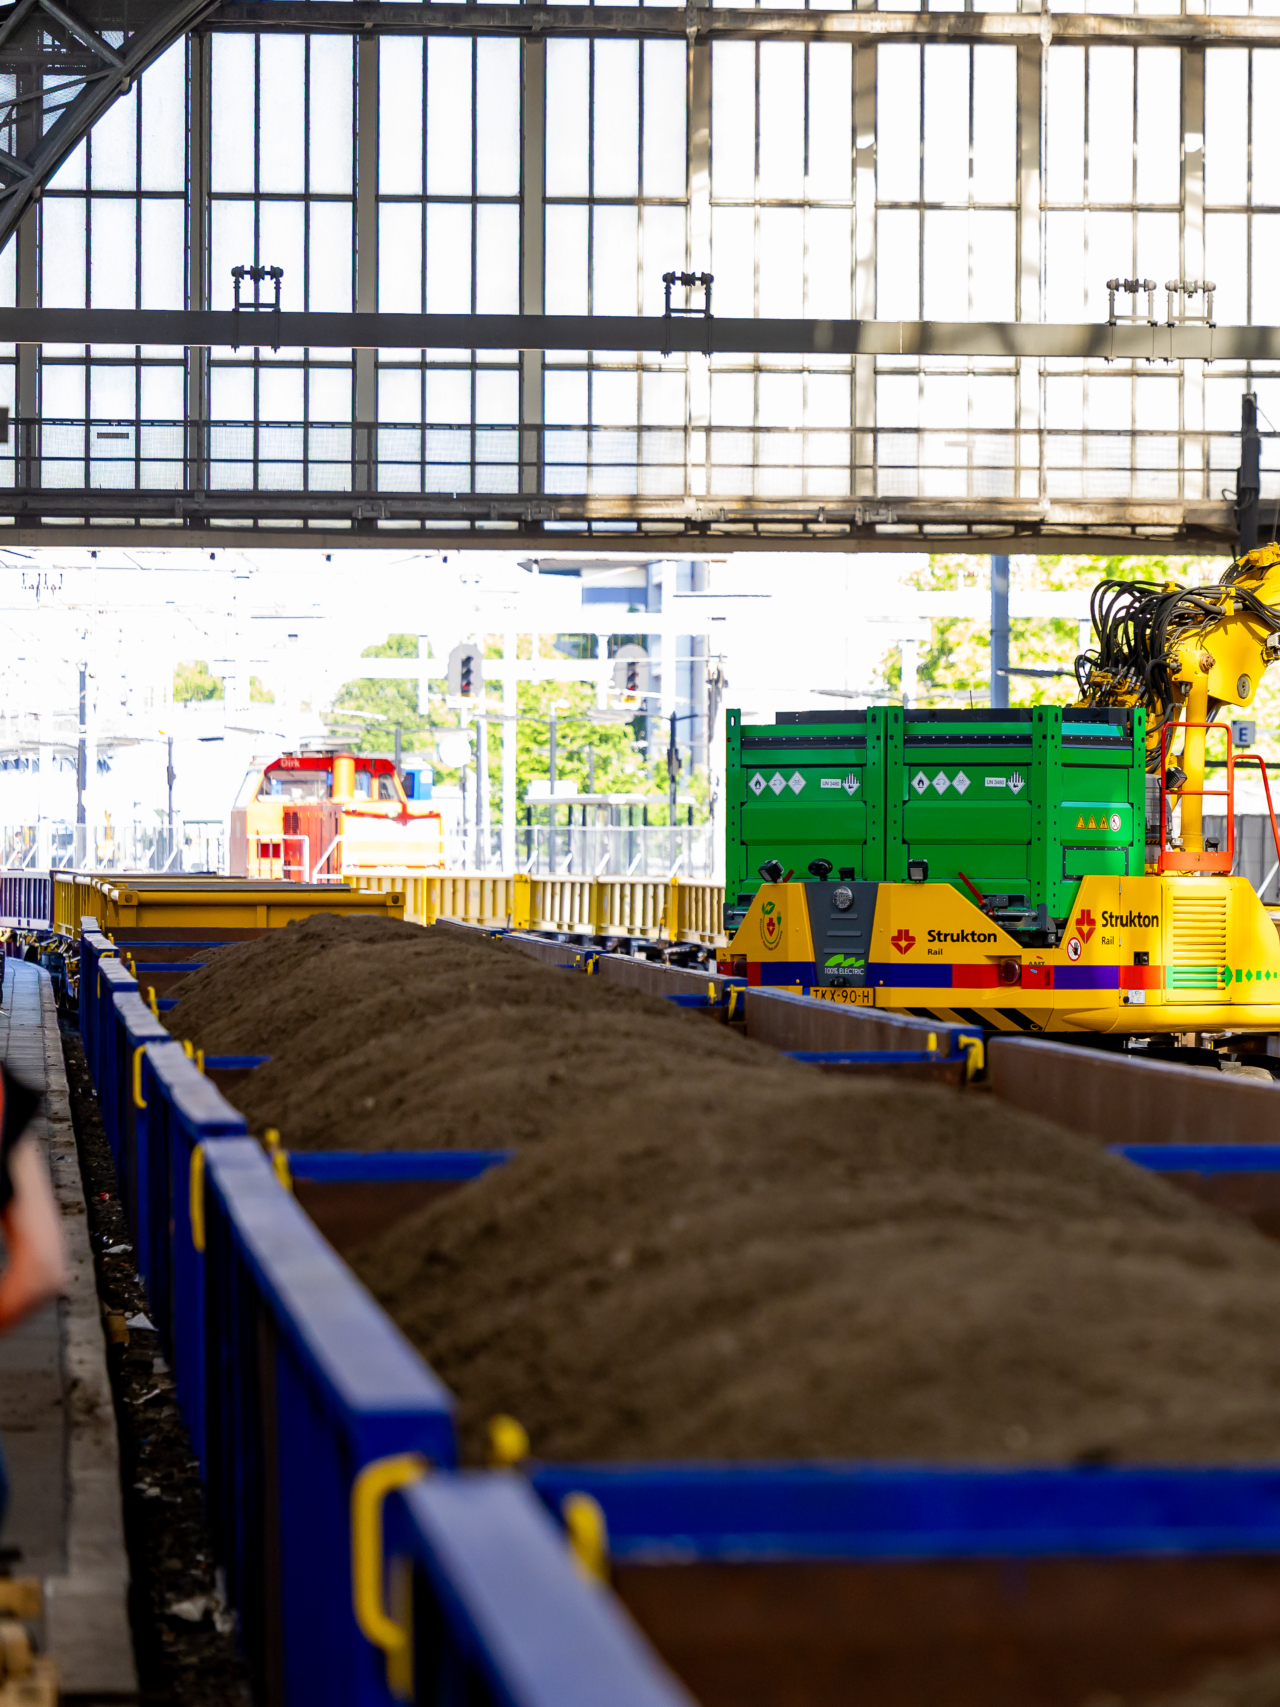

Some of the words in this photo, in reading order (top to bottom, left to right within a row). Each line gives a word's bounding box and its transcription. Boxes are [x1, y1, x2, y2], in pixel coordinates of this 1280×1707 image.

[1239, 727, 1248, 742] E
[280, 758, 301, 768] Dirk
[1101, 910, 1159, 928] Strukton
[927, 929, 997, 943] Strukton
[1101, 936, 1114, 945] Rail
[824, 967, 838, 975] 100%
[813, 989, 869, 1003] TKX-90-H
